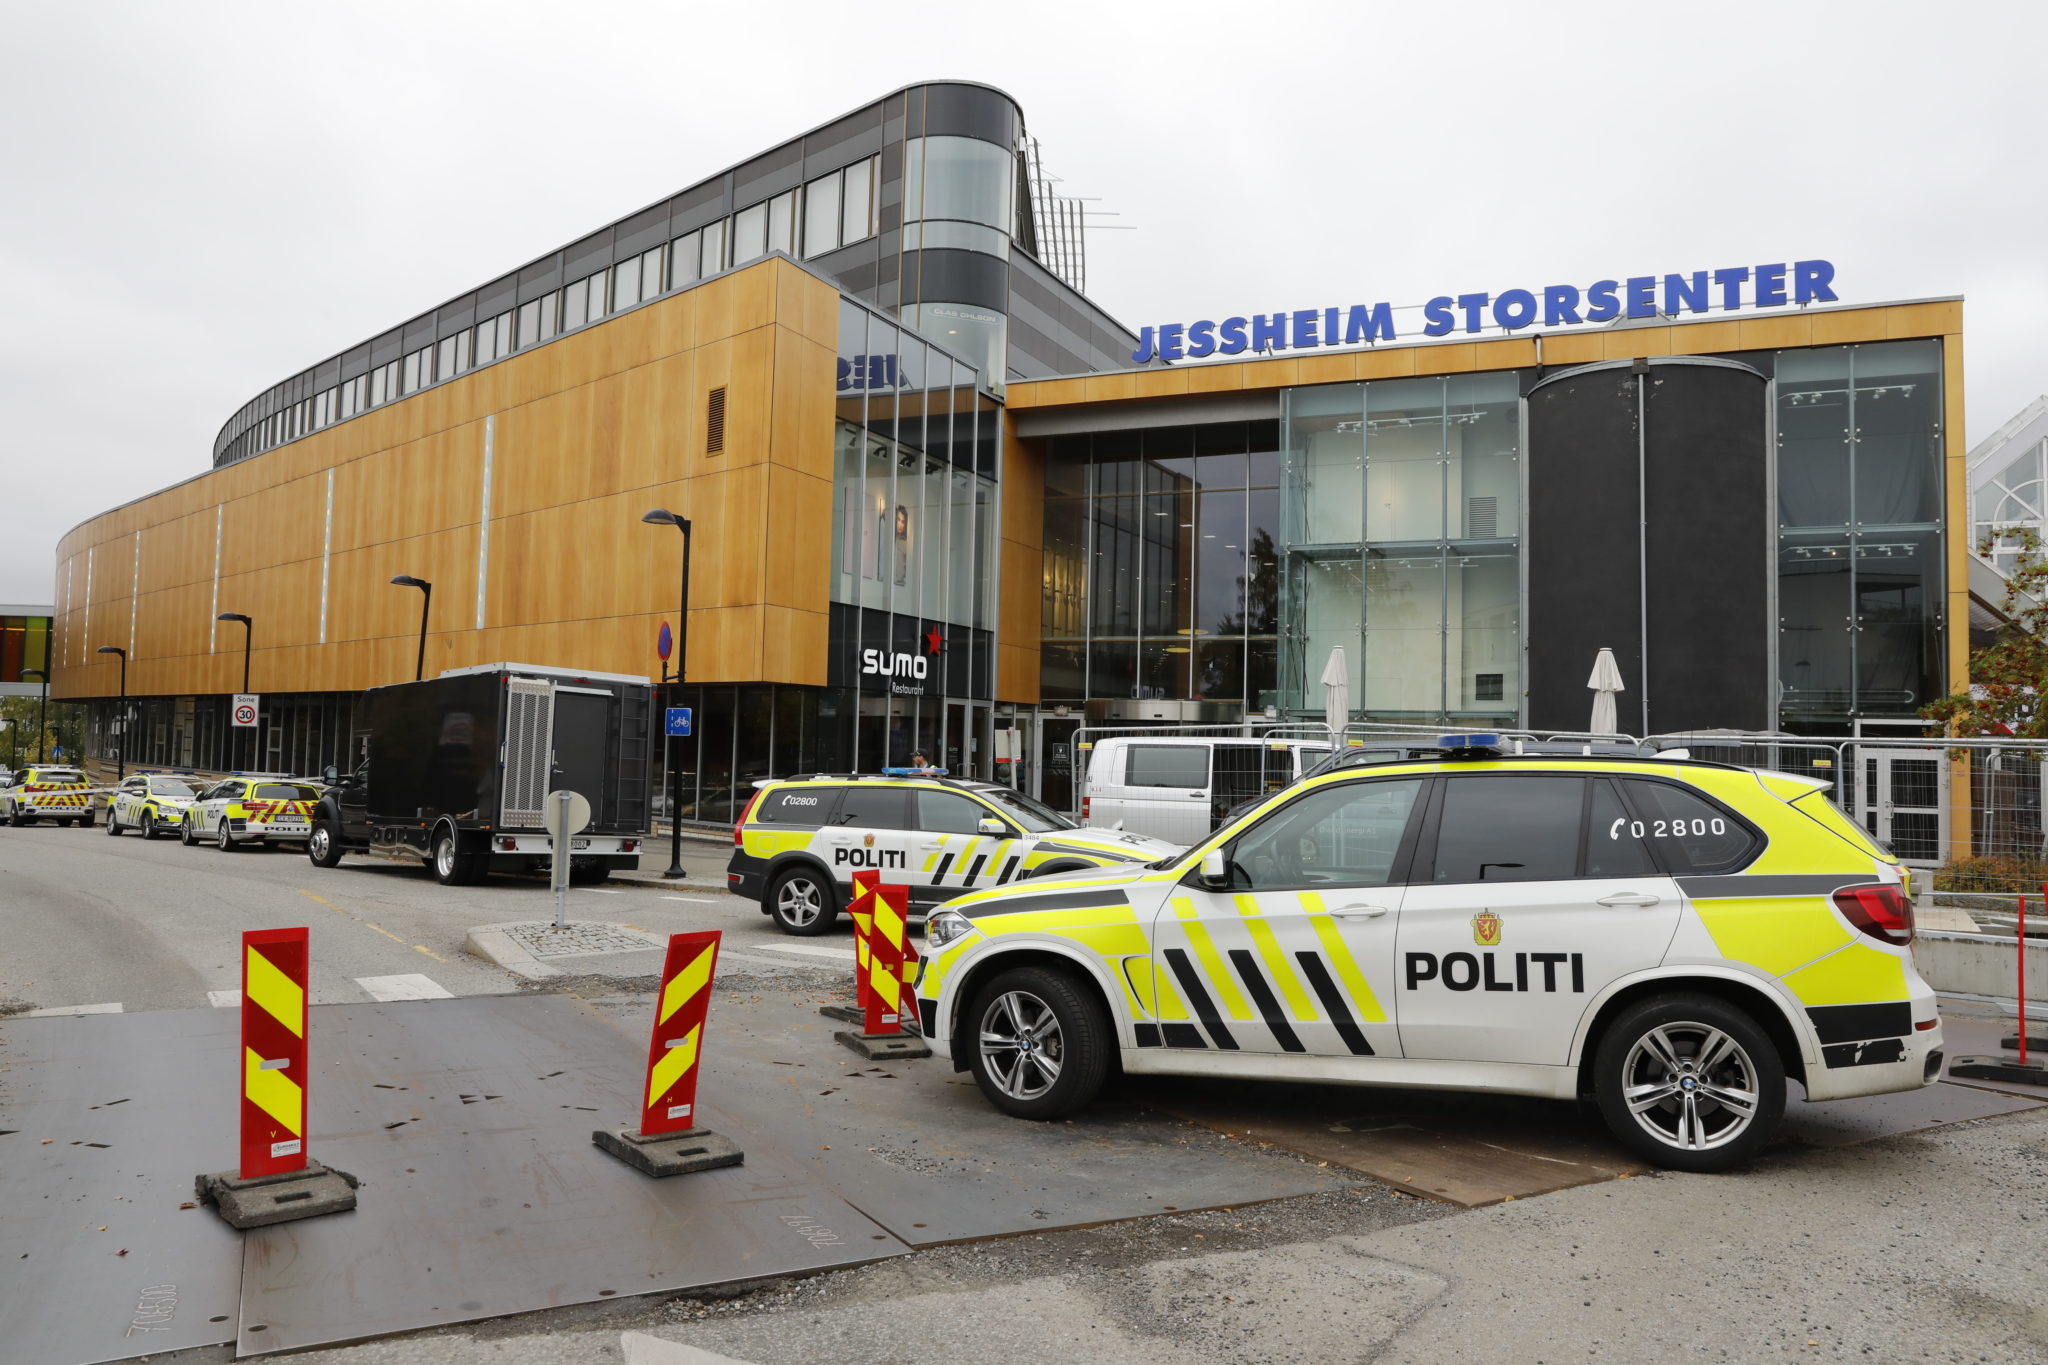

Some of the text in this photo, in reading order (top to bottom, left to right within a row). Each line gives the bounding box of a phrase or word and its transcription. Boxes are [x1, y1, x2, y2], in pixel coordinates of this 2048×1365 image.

[1131, 259, 1839, 364] JESSHEIM STORSENTER
[891, 681, 924, 695] Restaurant
[239, 710, 252, 719] 30
[789, 797, 818, 806] 02800
[1630, 818, 1726, 839] 02800
[835, 848, 906, 868] POLITI
[1406, 952, 1584, 993] POLITI
[270, 1130, 277, 1138] V
